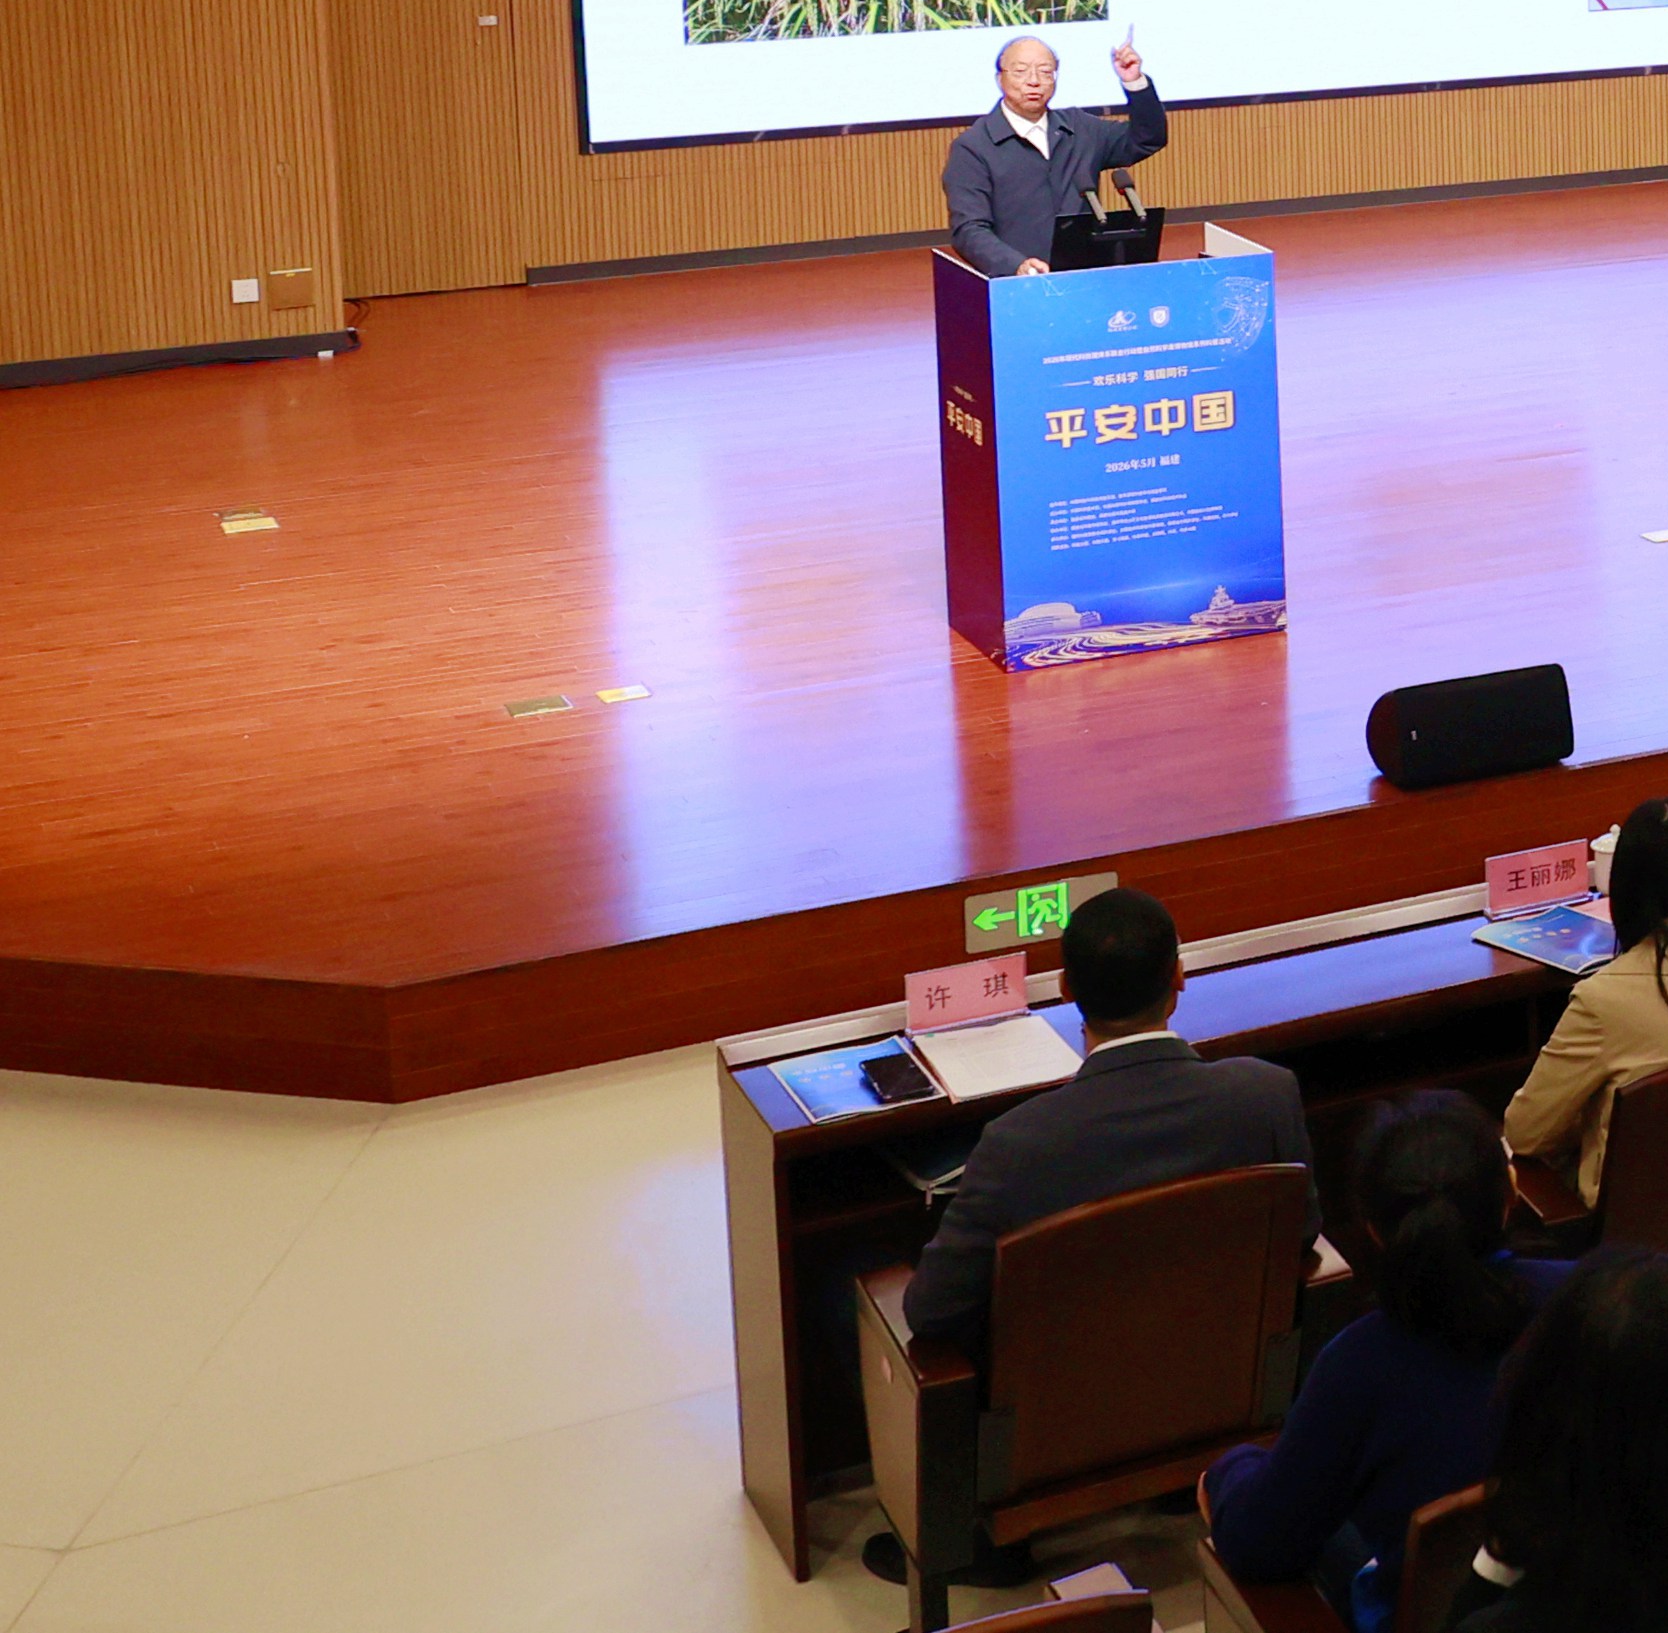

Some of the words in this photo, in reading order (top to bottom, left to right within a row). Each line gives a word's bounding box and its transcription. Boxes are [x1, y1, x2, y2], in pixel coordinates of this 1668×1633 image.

[1093, 371, 1138, 387] 欢乐科学
[946, 400, 983, 446] 平安中国
[1043, 390, 1235, 449] 平安中国
[1507, 858, 1577, 892] 王丽娜
[925, 972, 1009, 1010] 许琪
